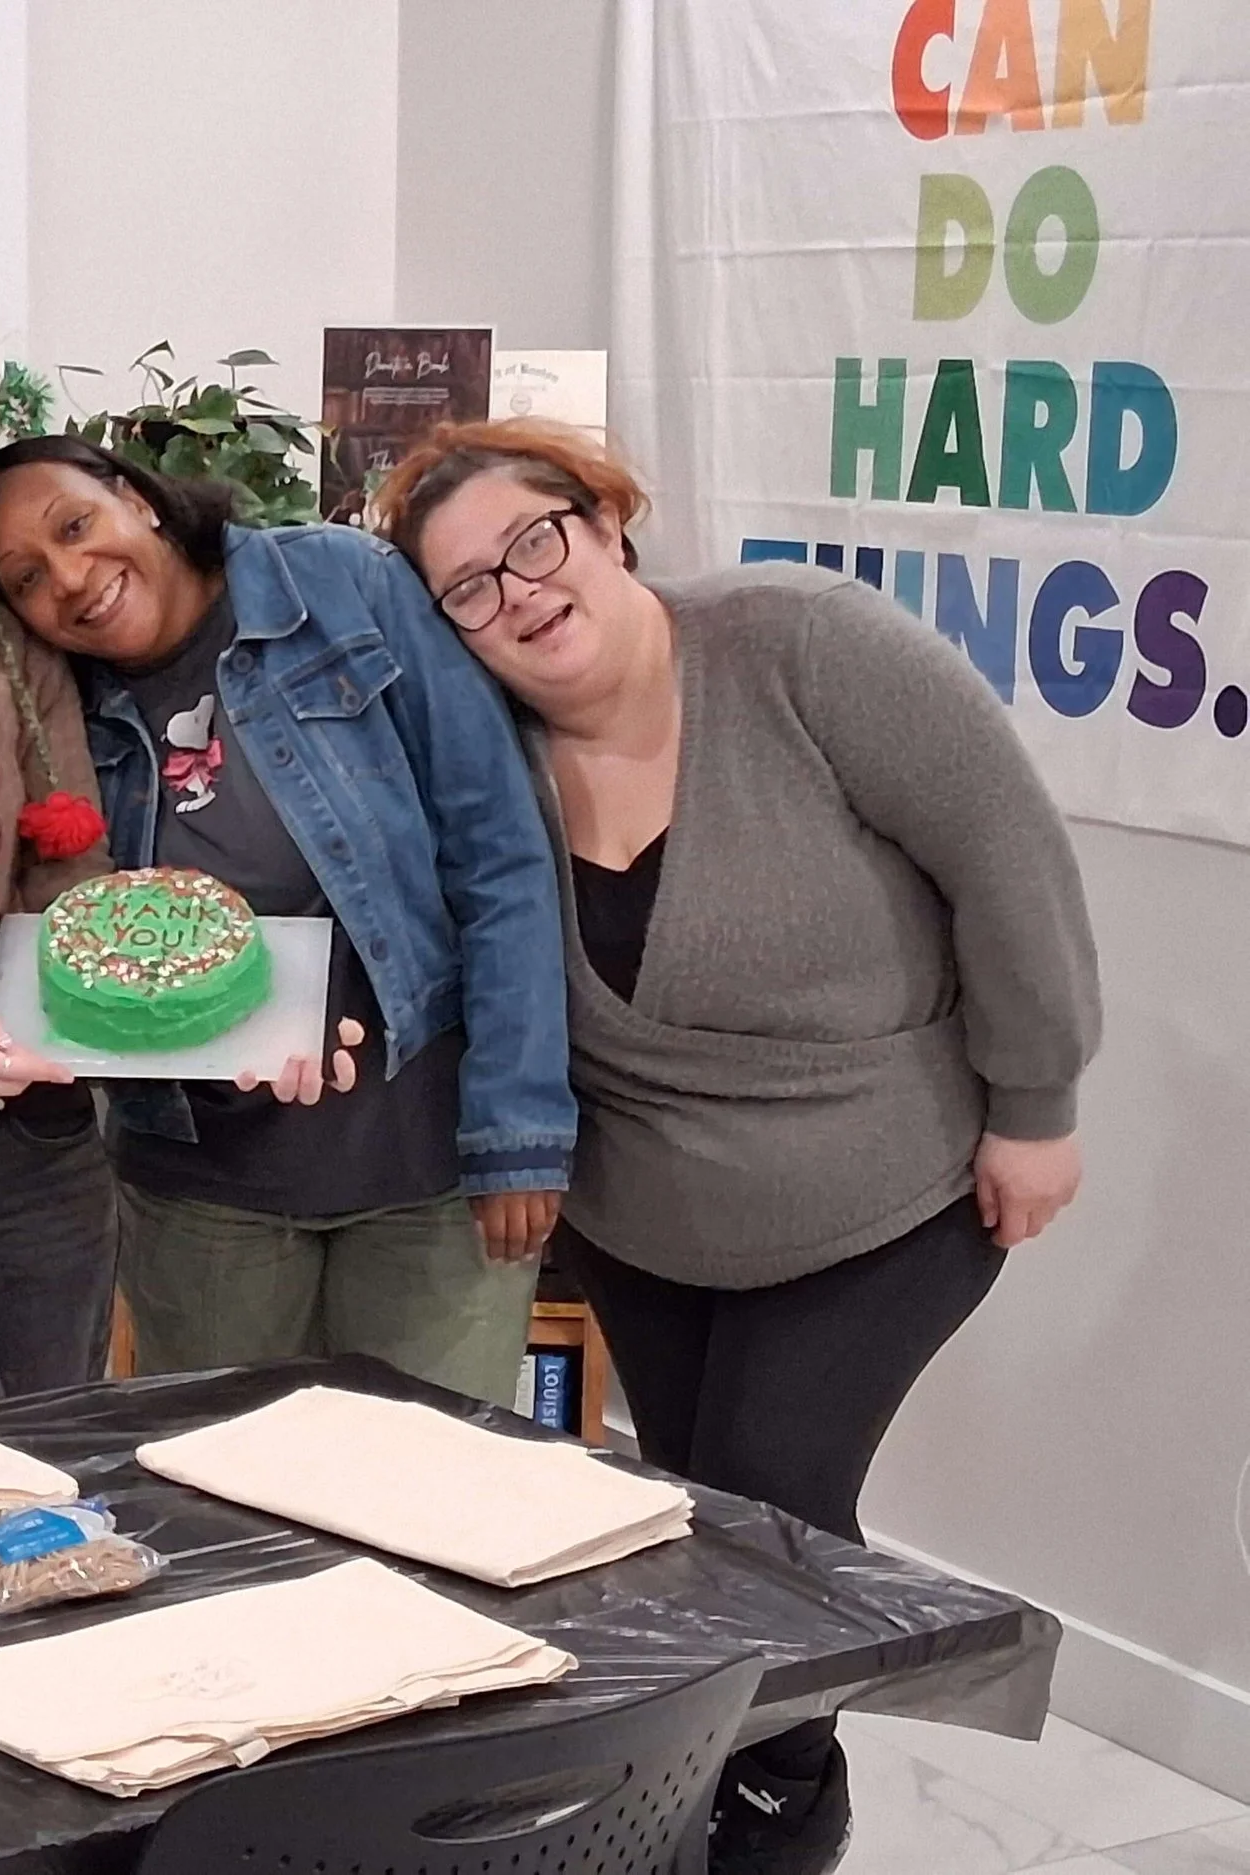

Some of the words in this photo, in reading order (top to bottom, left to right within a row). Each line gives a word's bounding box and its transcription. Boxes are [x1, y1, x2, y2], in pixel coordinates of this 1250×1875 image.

[892, 0, 1151, 139] CAN
[913, 165, 1100, 324] DO
[830, 357, 1178, 516] HARD
[70, 900, 220, 923] THANK
[113, 922, 199, 949] YOU!
